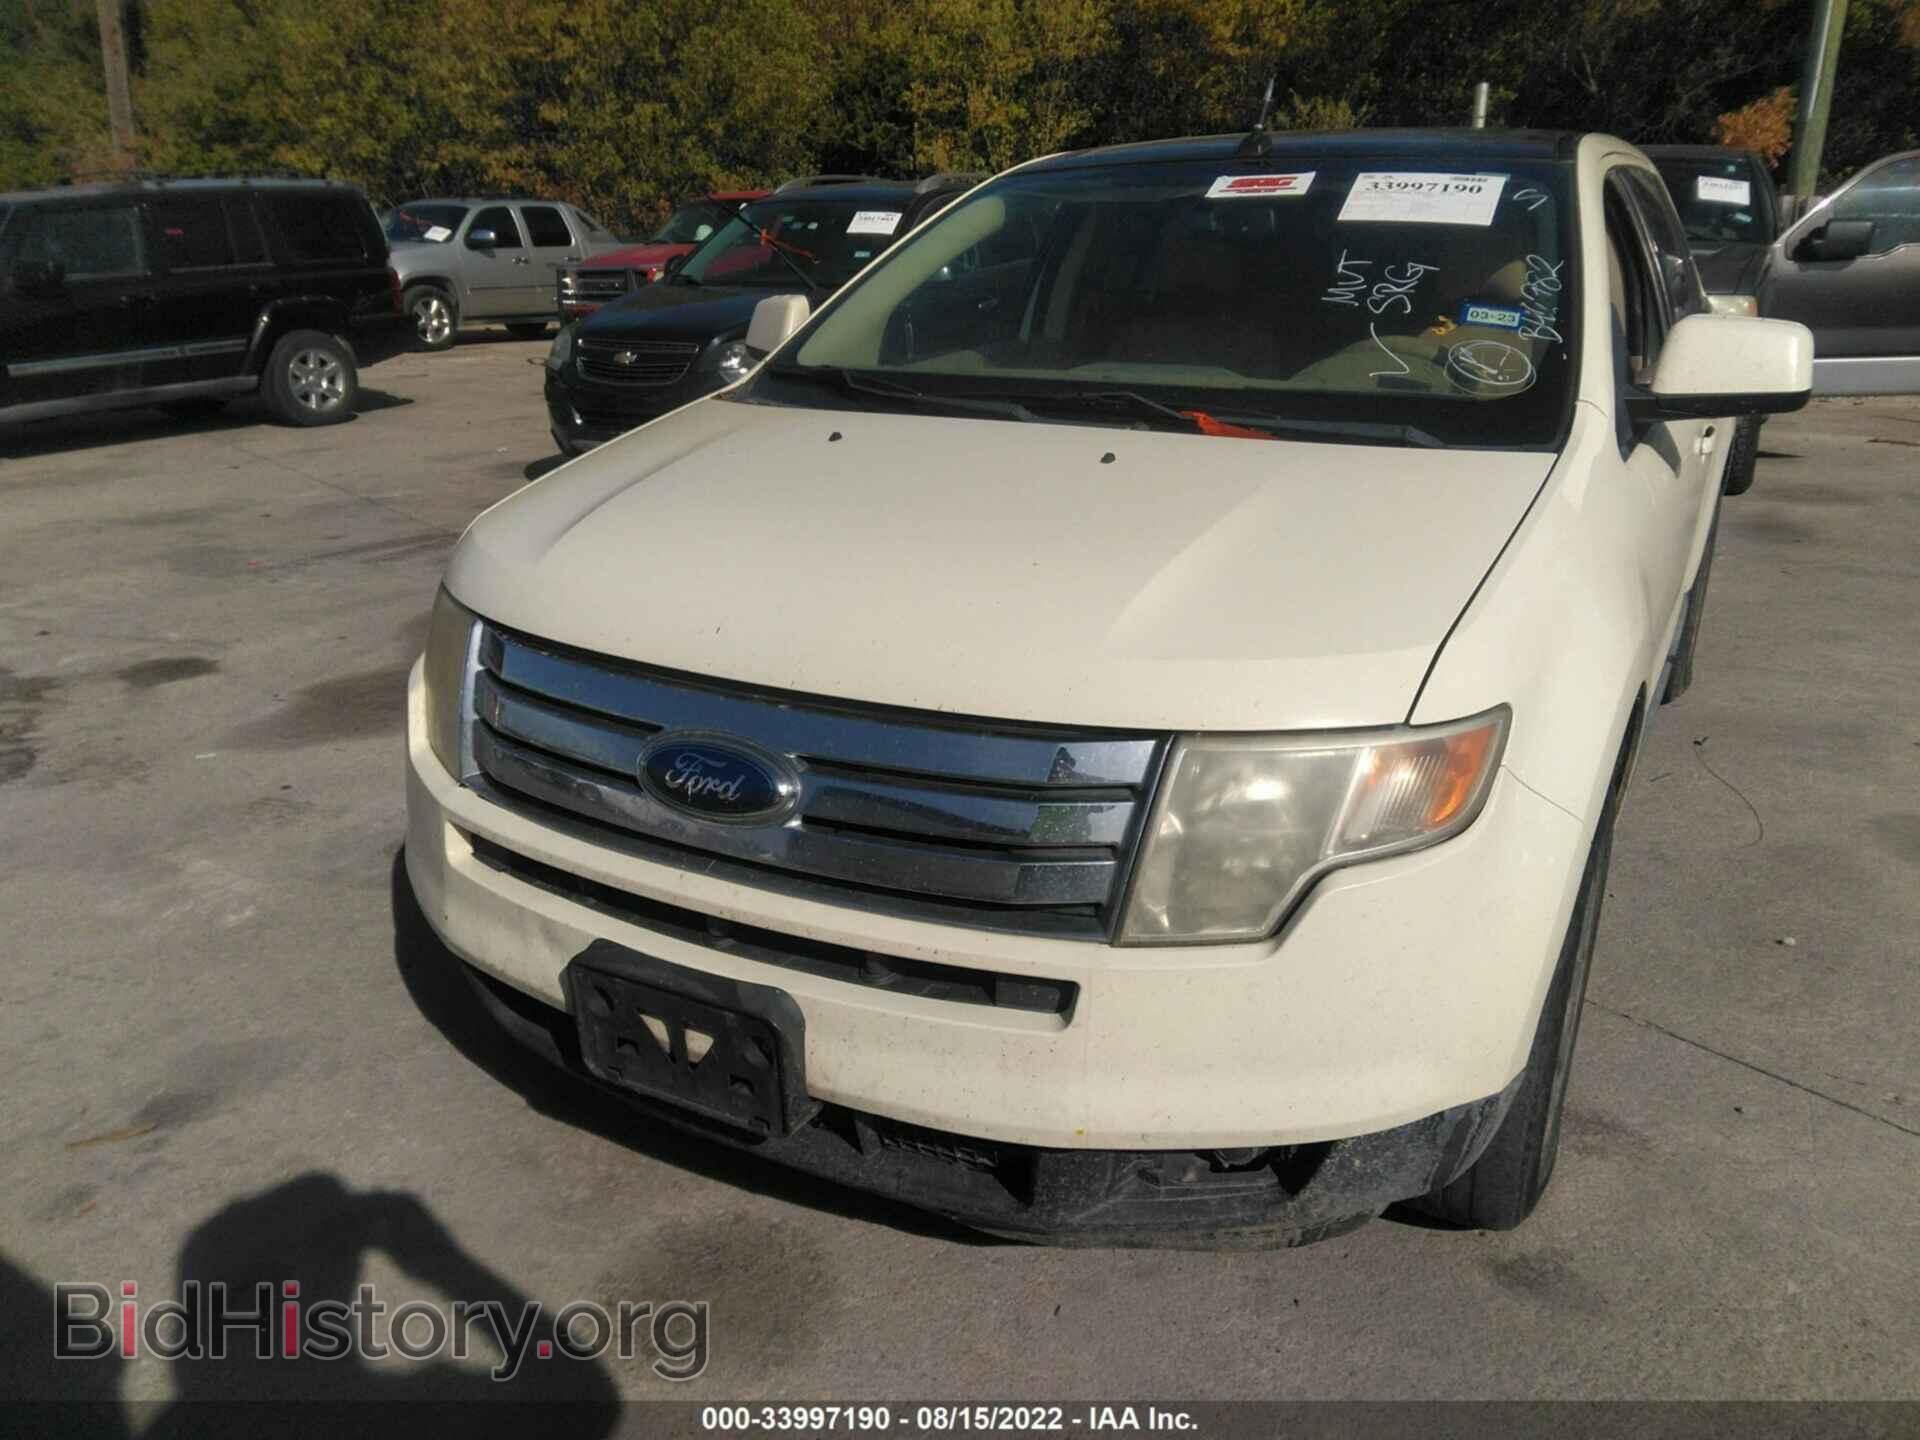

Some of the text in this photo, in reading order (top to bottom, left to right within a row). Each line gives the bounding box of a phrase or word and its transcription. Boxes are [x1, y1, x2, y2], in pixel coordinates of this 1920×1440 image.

[1370, 181, 1483, 194] 33997190
[1470, 310, 1516, 323] 03-23
[664, 752, 746, 801] Ford
